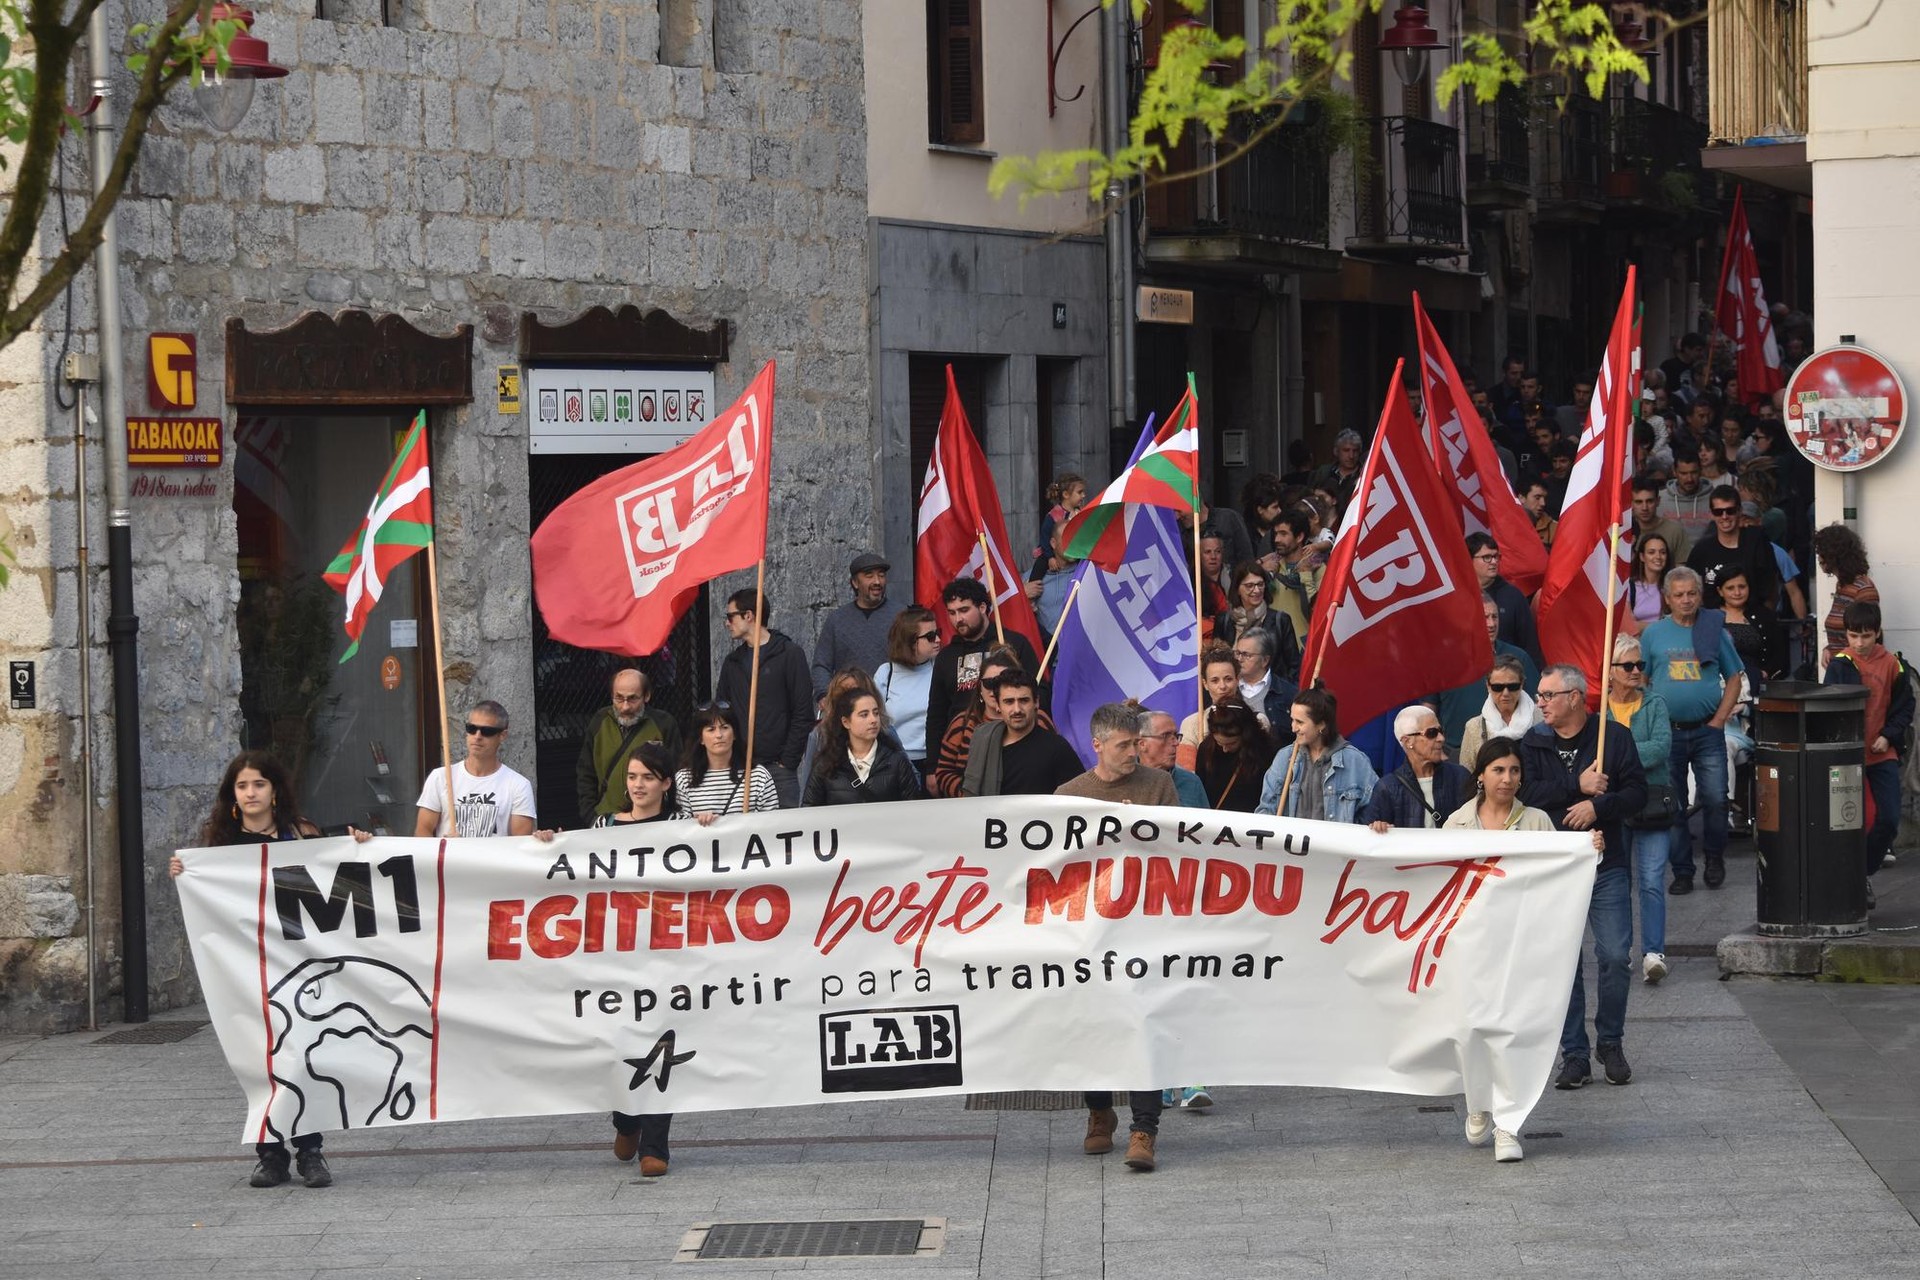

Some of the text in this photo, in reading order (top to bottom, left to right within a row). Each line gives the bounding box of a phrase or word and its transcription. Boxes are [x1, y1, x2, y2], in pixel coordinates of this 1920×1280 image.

[127, 421, 219, 450] TABAKOAK
[546, 815, 1311, 881] ANTOLATU BORROKATU
[272, 854, 421, 941] M1
[487, 883, 791, 961] EGITEKO
[813, 855, 1003, 969] beste
[1023, 856, 1304, 925] MUNDU
[574, 950, 1284, 1021] repartir para transformar
[828, 1013, 953, 1067] LAB
